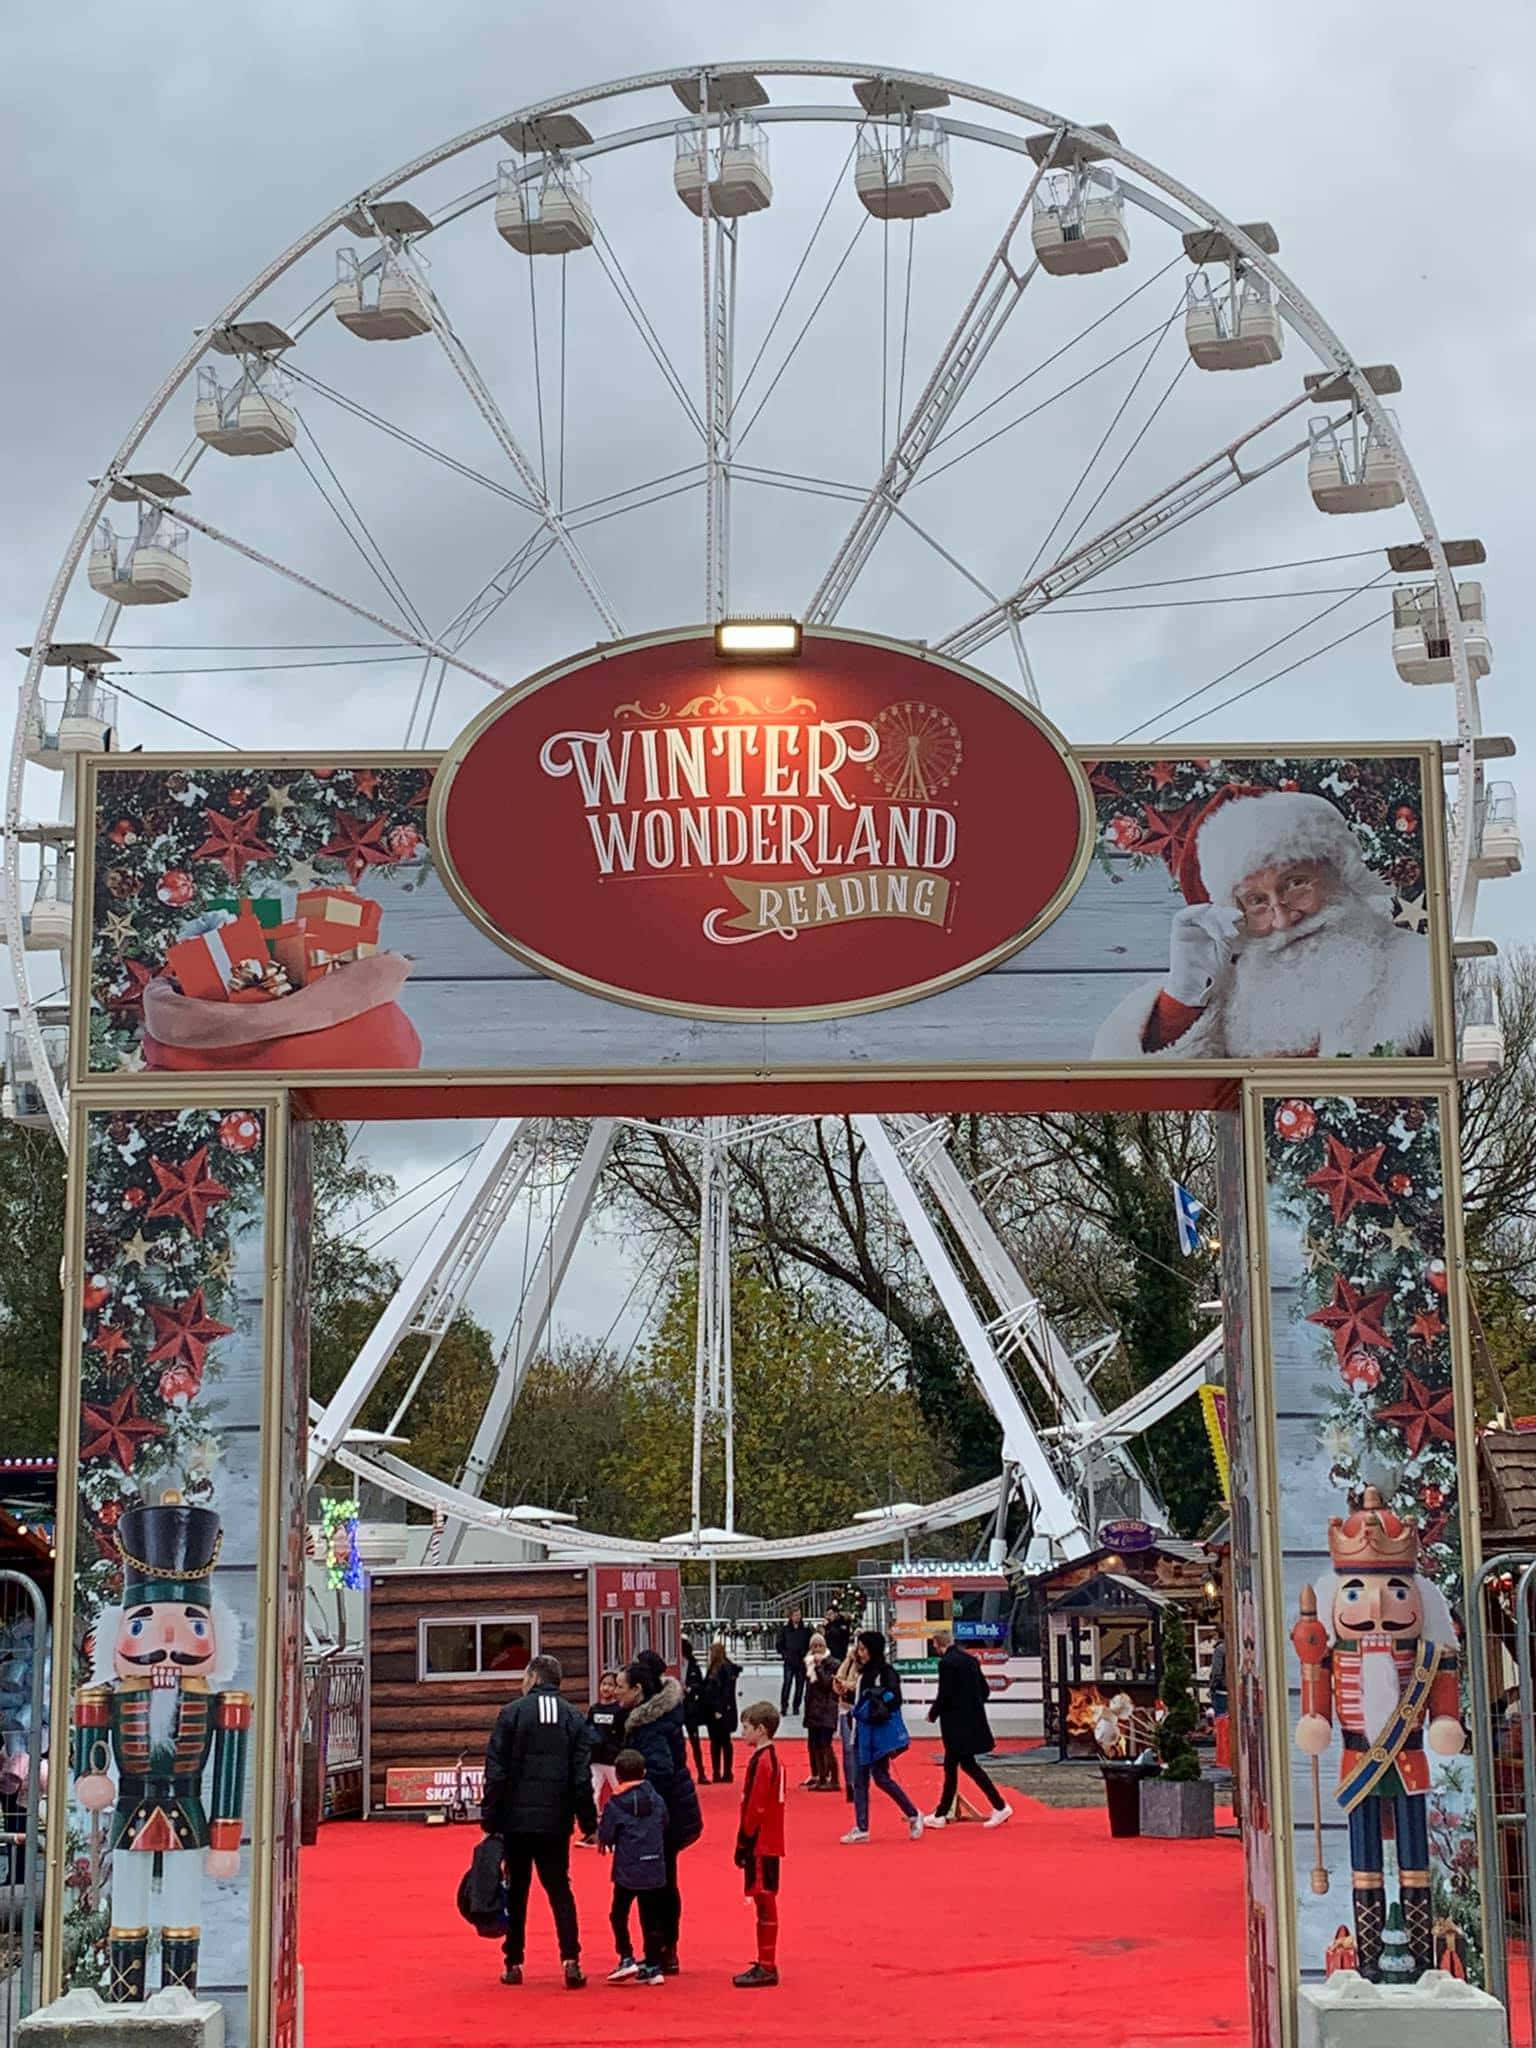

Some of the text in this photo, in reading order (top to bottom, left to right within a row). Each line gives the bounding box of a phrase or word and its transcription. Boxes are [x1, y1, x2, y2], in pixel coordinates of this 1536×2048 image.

[540, 720, 881, 810] WINTER
[585, 803, 957, 875] WONDERLAND
[702, 874, 936, 945] READING
[975, 1623, 1000, 1636] Rink
